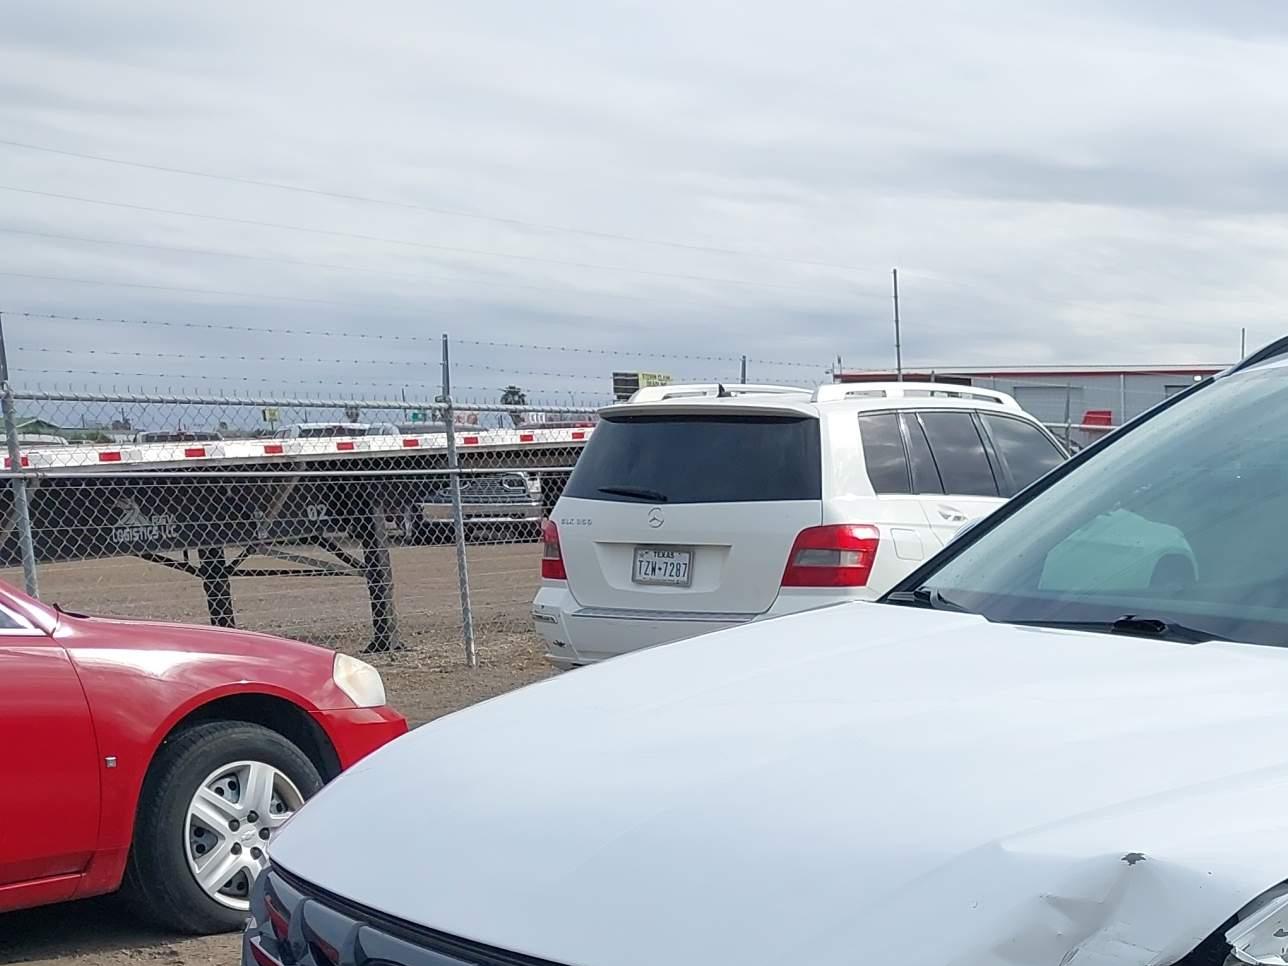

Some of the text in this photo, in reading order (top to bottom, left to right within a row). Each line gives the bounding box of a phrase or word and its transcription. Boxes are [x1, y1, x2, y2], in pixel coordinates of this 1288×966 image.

[307, 504, 328, 521] 02
[112, 524, 177, 542] LOGISTICS LLC
[653, 551, 675, 559] TEXAS
